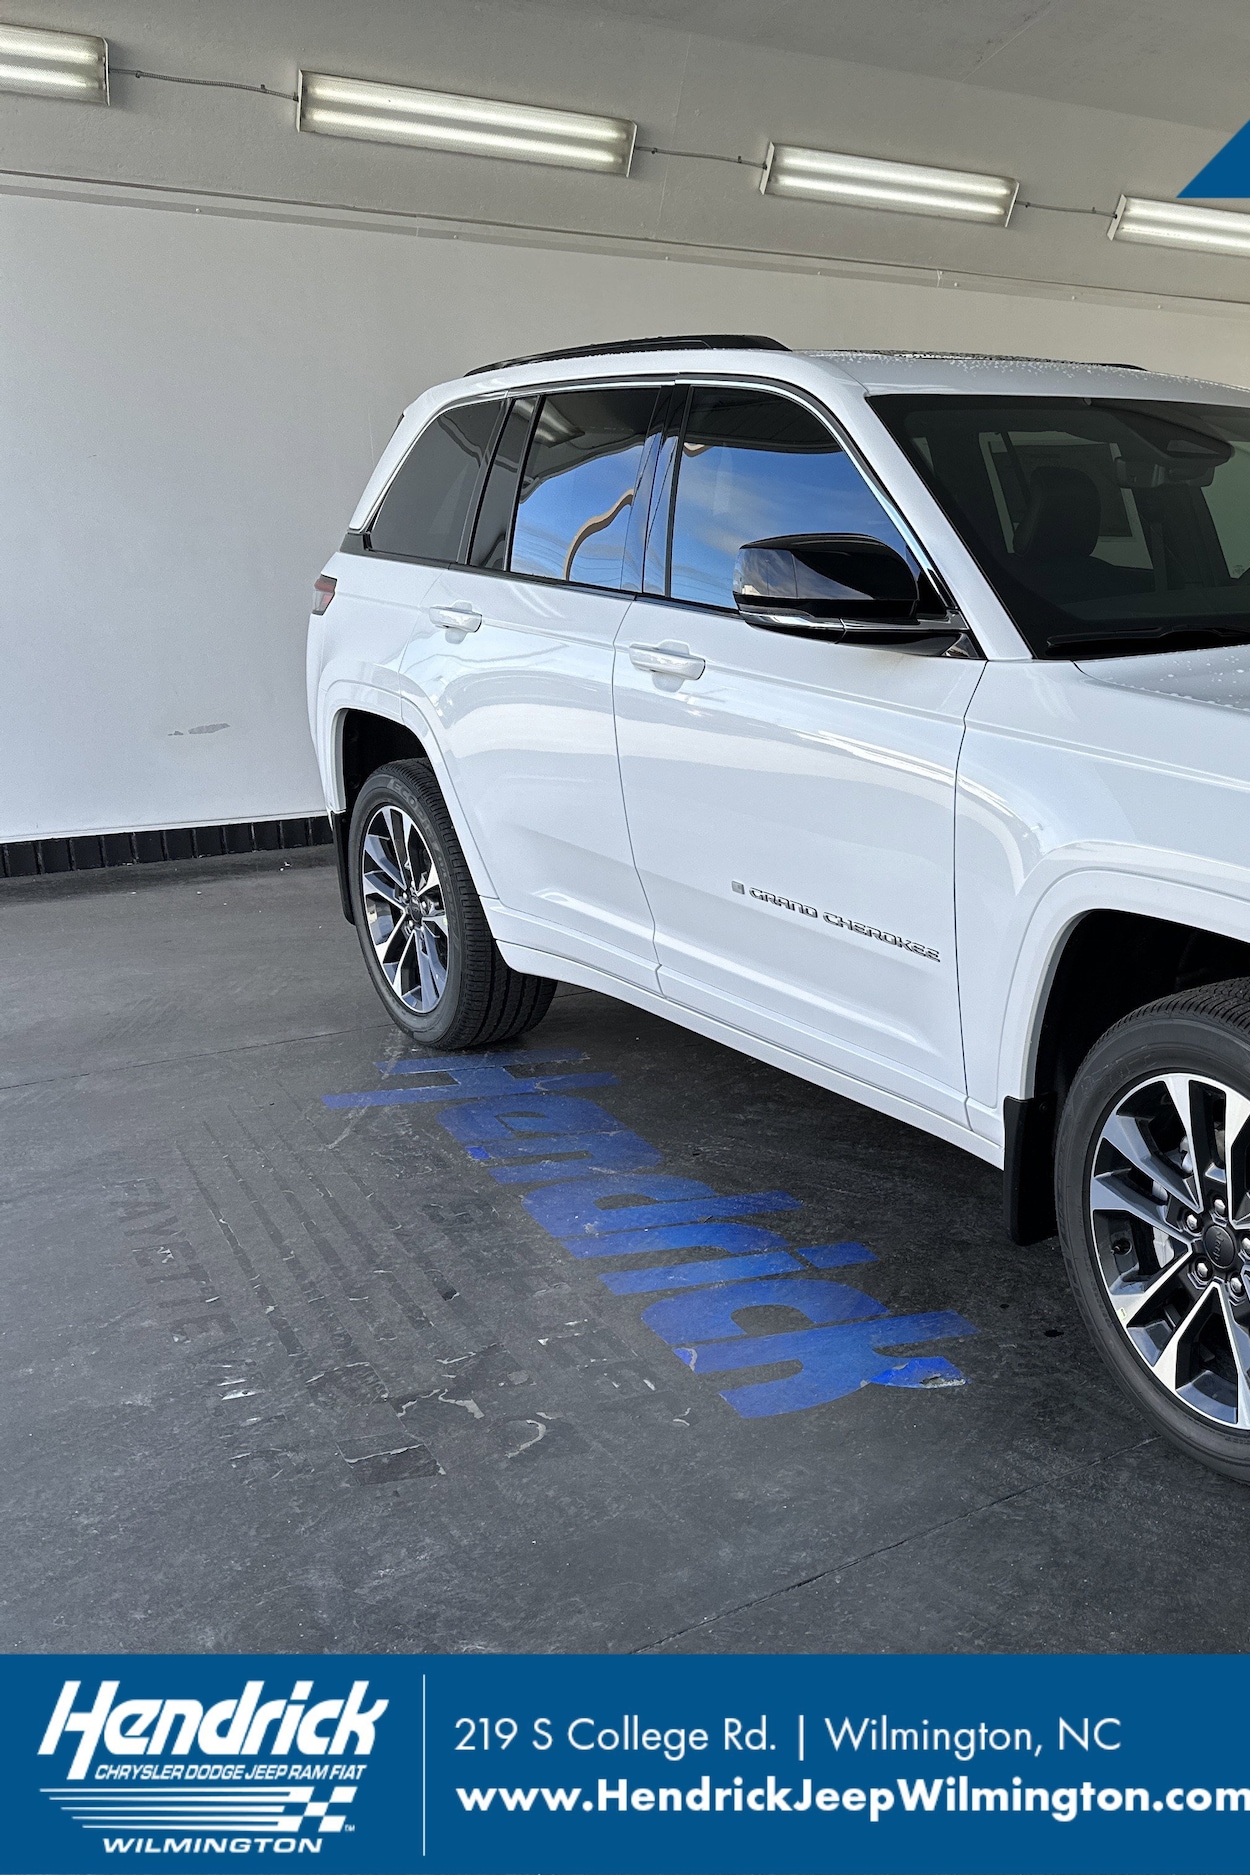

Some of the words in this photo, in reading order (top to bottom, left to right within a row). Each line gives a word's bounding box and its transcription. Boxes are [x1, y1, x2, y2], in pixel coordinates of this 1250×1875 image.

[749, 887, 818, 919] GRAND
[823, 912, 941, 963] CHEROKEE
[321, 1048, 979, 1420] Hendrick
